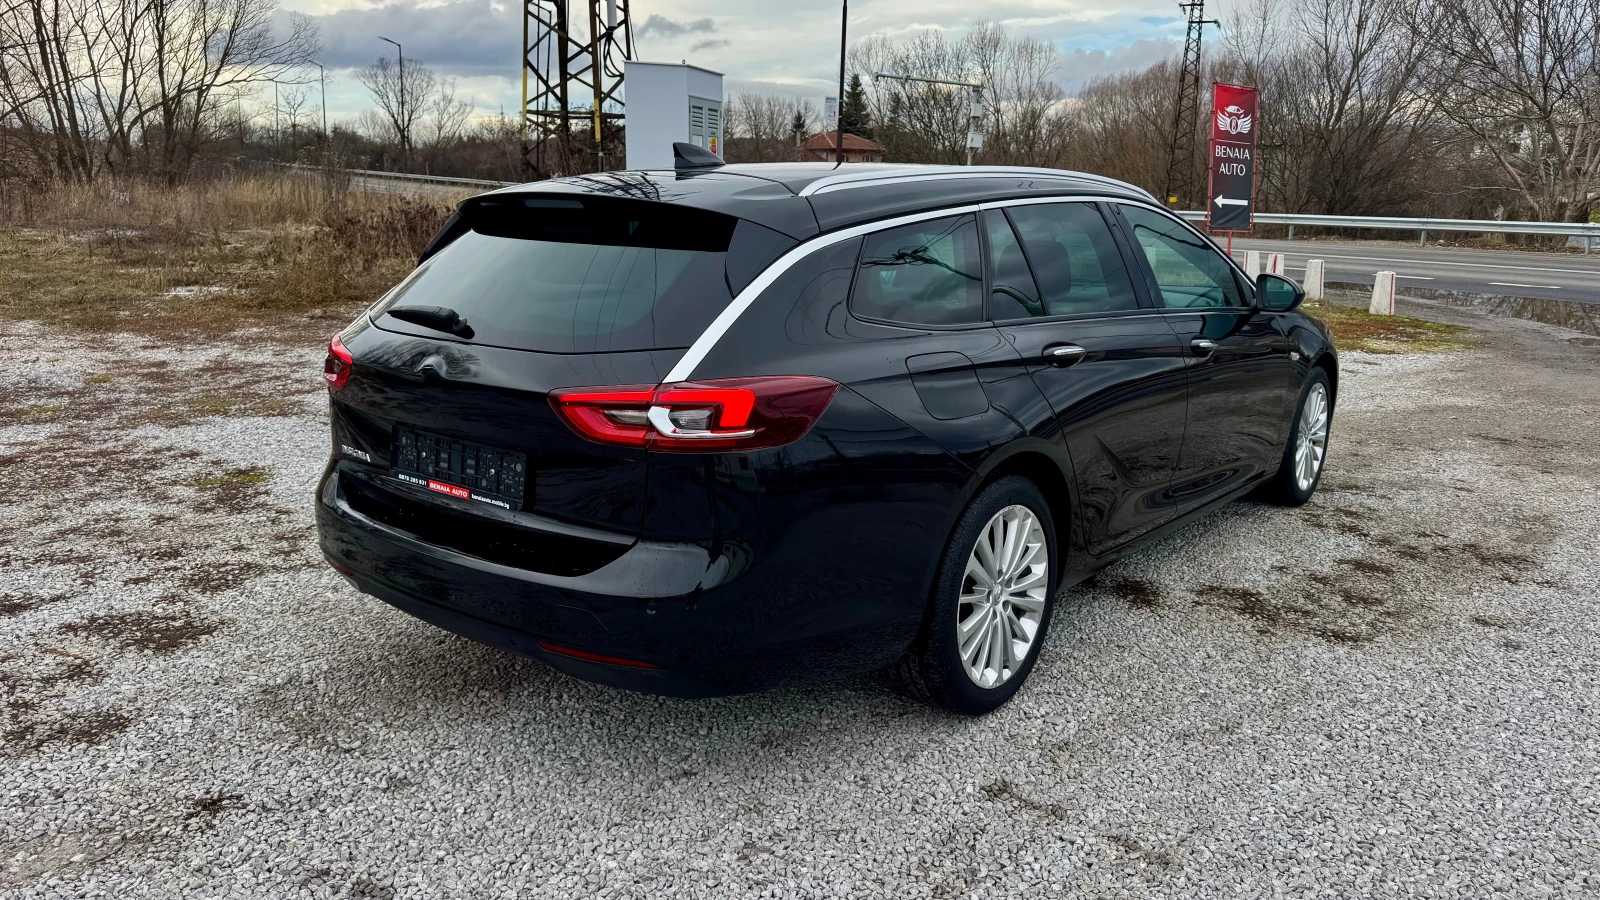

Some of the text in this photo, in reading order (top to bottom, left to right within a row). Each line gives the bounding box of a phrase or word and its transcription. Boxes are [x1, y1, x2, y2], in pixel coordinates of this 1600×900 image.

[1215, 145, 1250, 160] BENAIA
[1219, 162, 1246, 176] AUTO
[429, 482, 451, 493] BENAIA
[451, 489, 468, 498] AUTO
